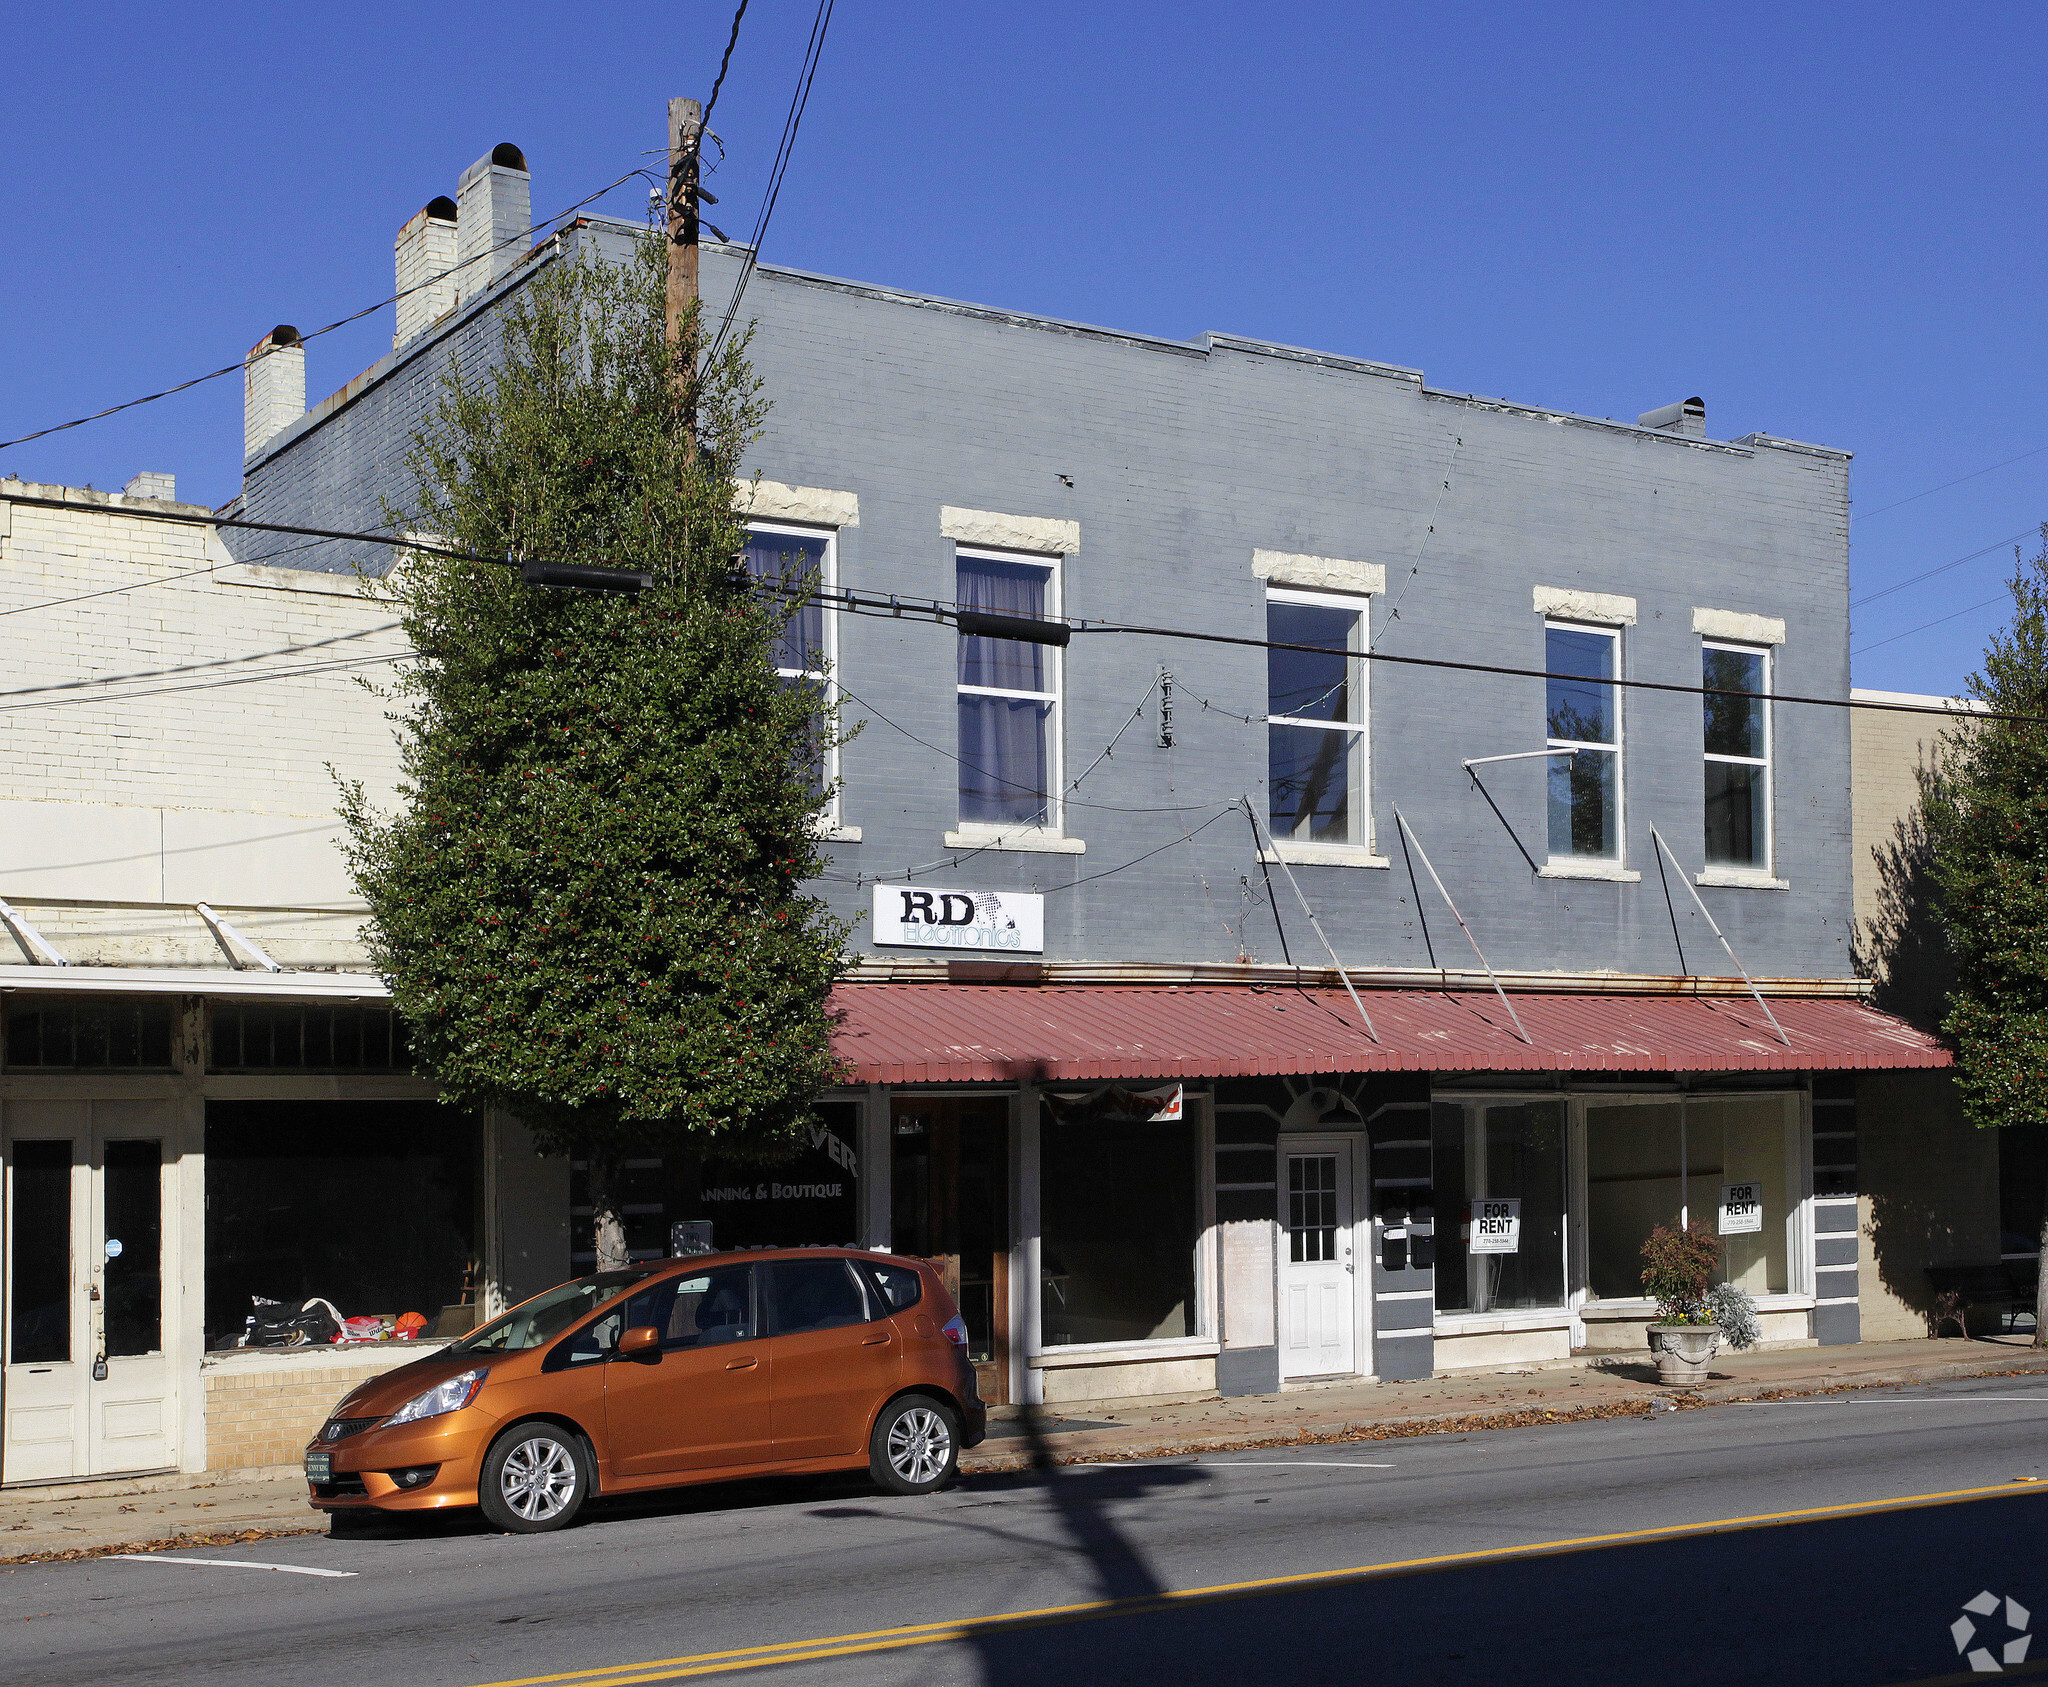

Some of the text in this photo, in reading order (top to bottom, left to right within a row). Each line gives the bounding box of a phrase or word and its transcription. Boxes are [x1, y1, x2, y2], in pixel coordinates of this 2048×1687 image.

[900, 891, 975, 926] RD
[904, 922, 1021, 948] Electronics
[755, 1183, 768, 1200] &
[771, 1183, 842, 1199] BOUTIQUE
[1729, 1186, 1752, 1200] FOR
[1484, 1203, 1509, 1218] FOR
[1726, 1201, 1756, 1216] RENT
[1479, 1219, 1513, 1234] RENT
